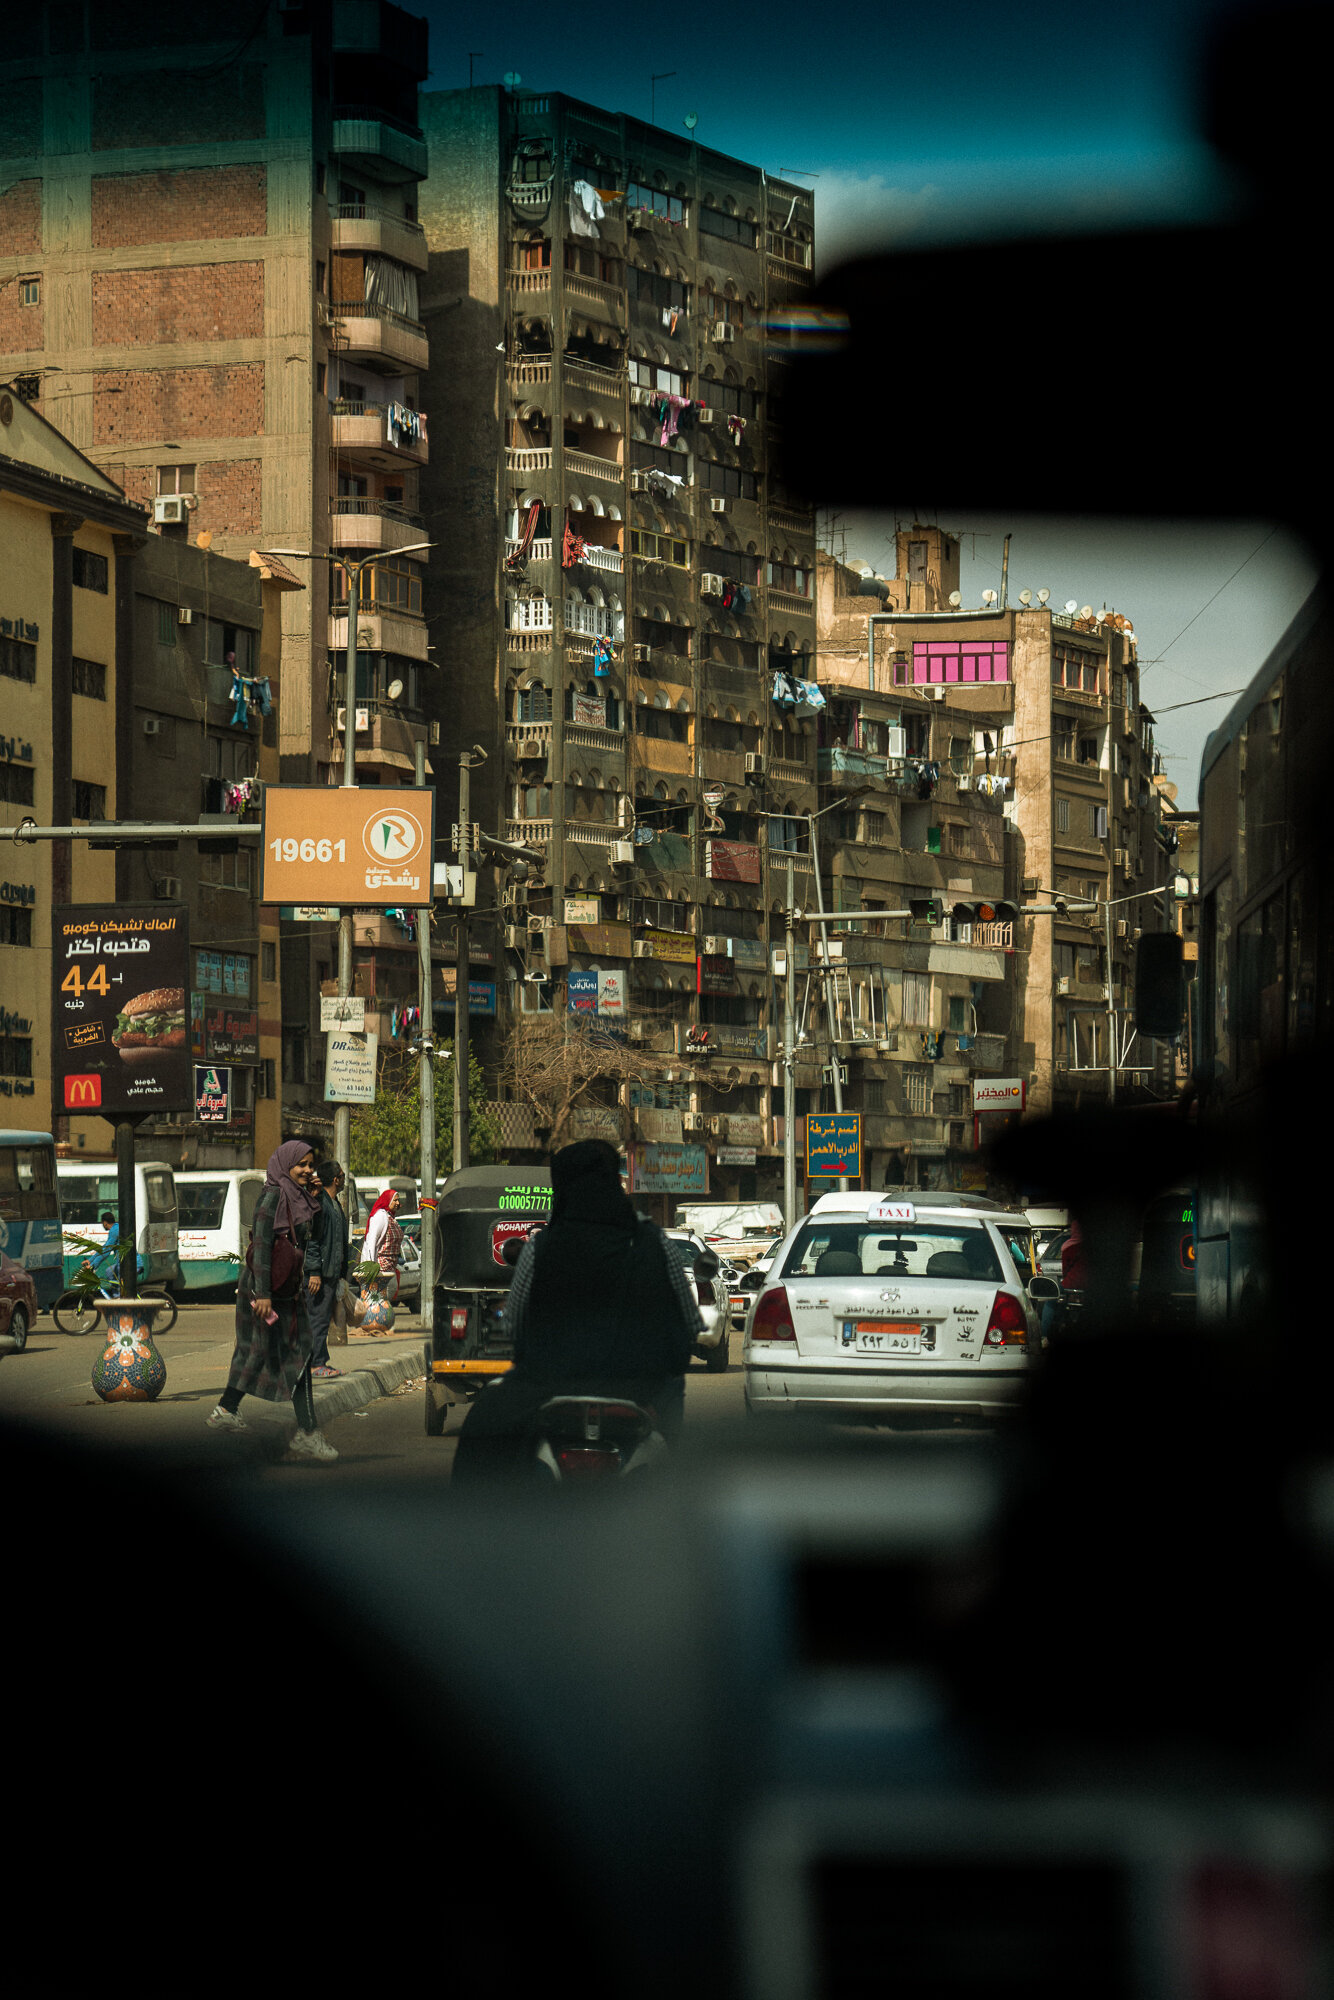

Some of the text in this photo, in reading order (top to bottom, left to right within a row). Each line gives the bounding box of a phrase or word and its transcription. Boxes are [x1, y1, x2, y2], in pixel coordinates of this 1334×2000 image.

[270, 838, 346, 863] 19661
[62, 918, 176, 936] الماك تشيكن كومبو
[103, 937, 151, 957] هتحبه
[61, 963, 111, 998] 44
[64, 999, 84, 1010] جنيه
[976, 1087, 1010, 1100] المختبر
[810, 1119, 857, 1139] قسم شرطة
[836, 1141, 858, 1159] الدرب
[499, 1195, 553, 1210] 0100057771
[877, 1208, 911, 1218] TAXI
